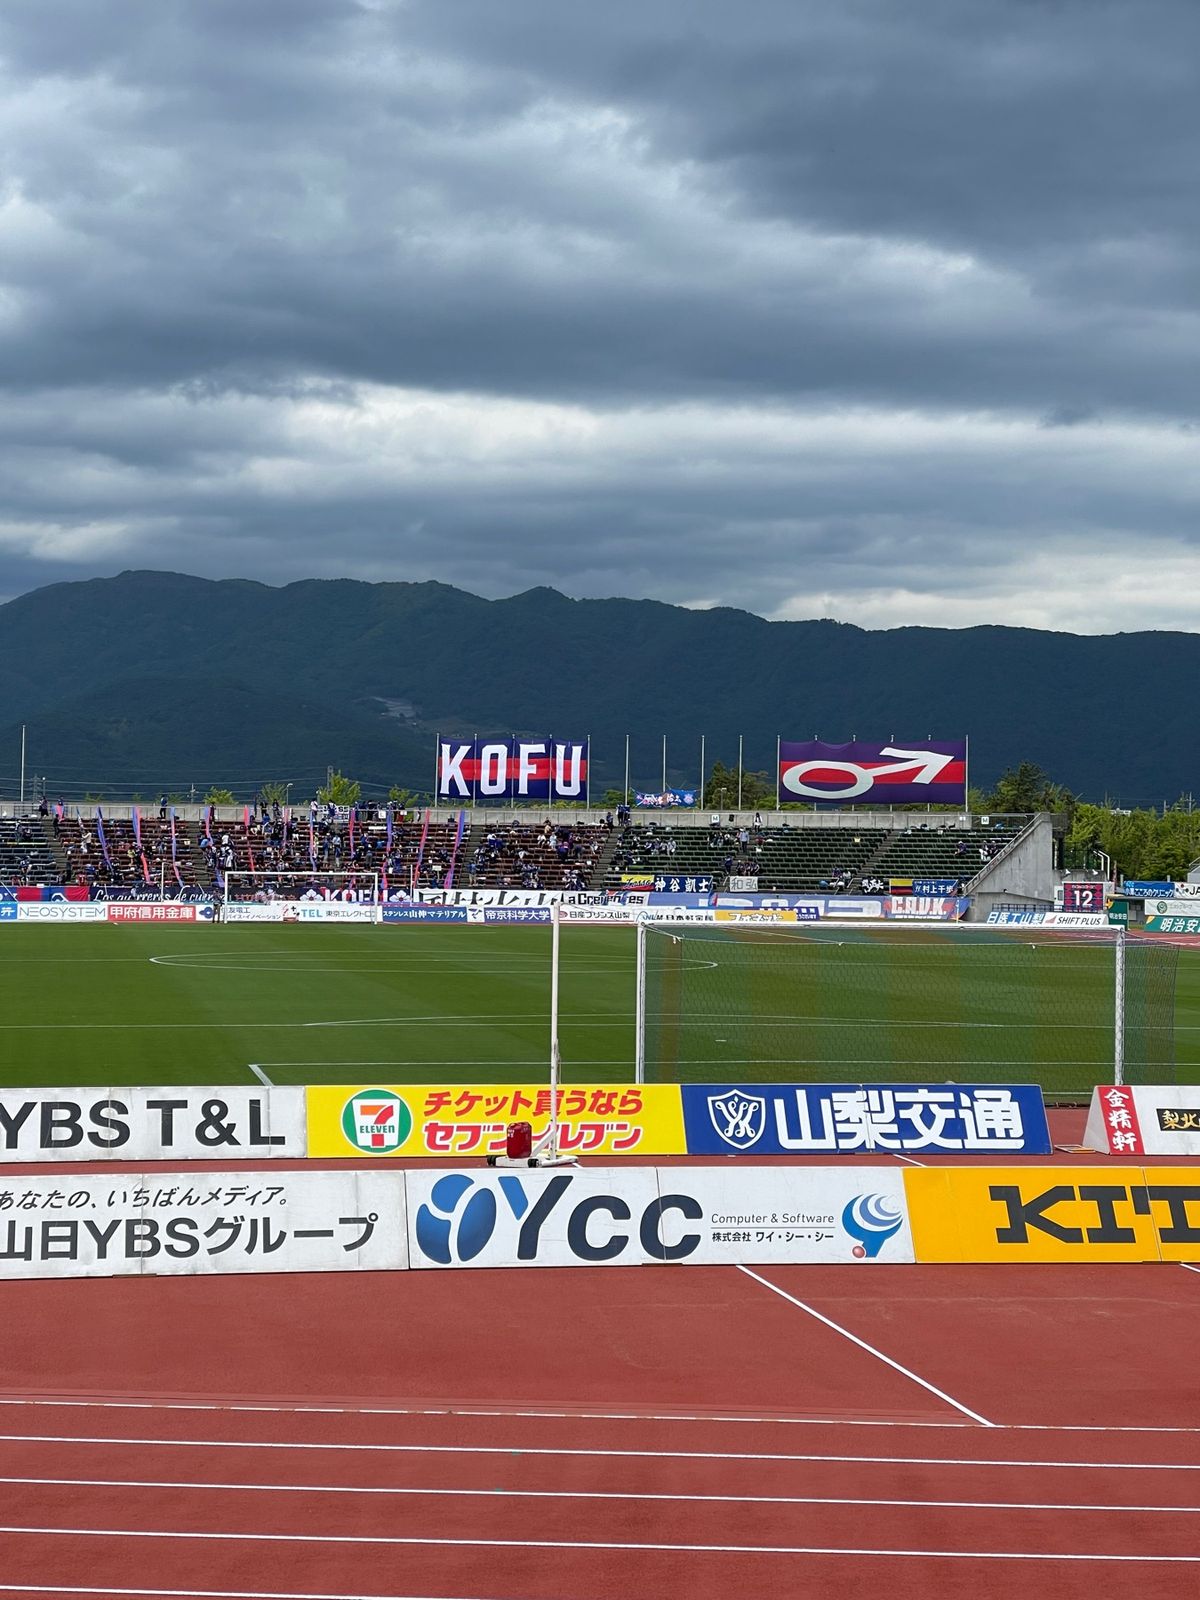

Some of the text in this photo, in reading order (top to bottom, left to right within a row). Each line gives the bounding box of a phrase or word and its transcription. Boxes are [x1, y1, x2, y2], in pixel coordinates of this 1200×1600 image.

[440, 743, 583, 796] KOFU
[1073, 890, 1093, 906] 12
[19, 906, 106, 917] NEOSYSTEM
[110, 906, 194, 919] 甲府信用金庫
[301, 909, 323, 917] TEL
[485, 909, 550, 921] 帝京科学大学
[569, 911, 630, 919] 日産プリンス山梨
[987, 911, 1044, 924] 日医工山梨
[1057, 916, 1101, 925] SHIFT PLUS
[1160, 918, 1200, 932] 明治安
[424, 1090, 642, 1116] チケット買うなら
[774, 1089, 1024, 1150] 山梨交通
[1104, 1089, 1137, 1151] 金精軒
[1162, 1110, 1200, 1129] 梨北
[711, 1213, 834, 1225] Computer & Software
[712, 1231, 834, 1242] 株式会社 ワイ・シー・シー
